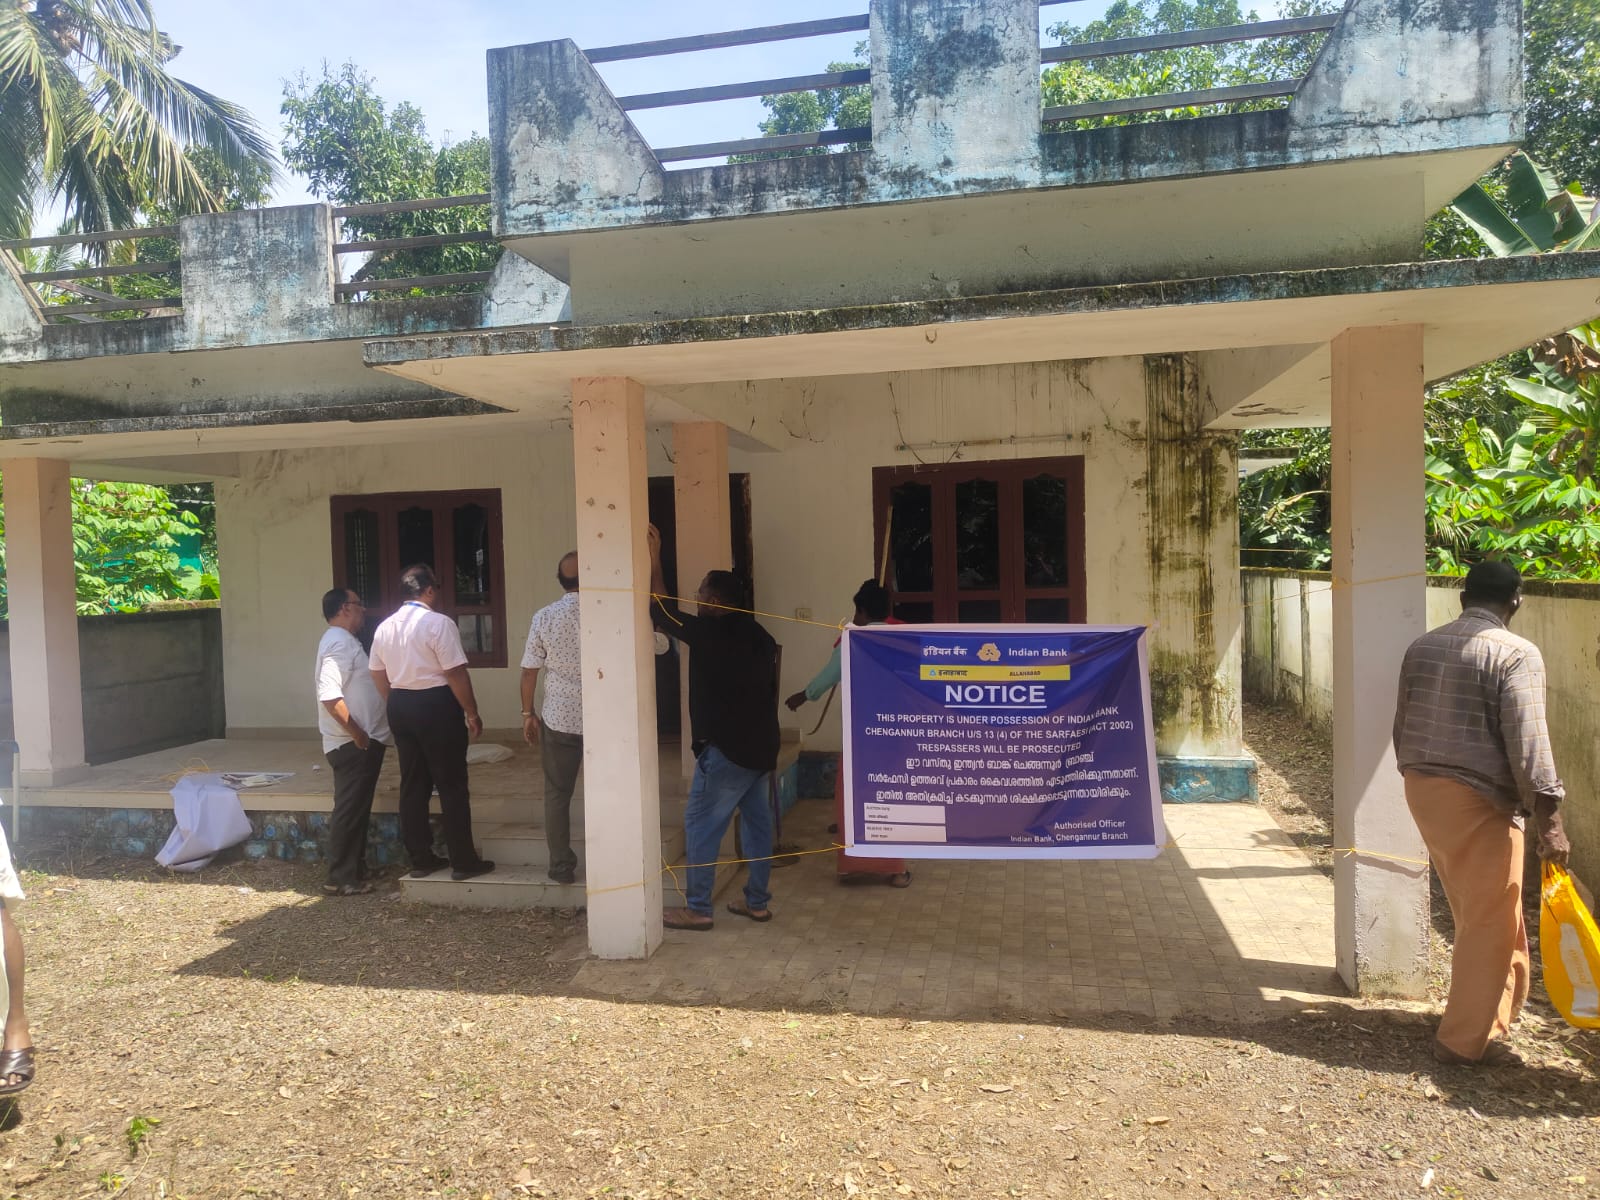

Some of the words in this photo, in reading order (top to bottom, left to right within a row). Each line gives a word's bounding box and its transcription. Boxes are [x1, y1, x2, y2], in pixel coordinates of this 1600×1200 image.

[1009, 648, 1039, 656] Indian
[1042, 648, 1067, 656] Bank
[945, 685, 1046, 703] NOTICE
[877, 713, 895, 722] THIS
[898, 714, 944, 723] PROPERTY
[947, 715, 955, 724] IS
[957, 716, 988, 724] UNDER
[991, 716, 1050, 724] POSSESSION
[1052, 715, 1065, 724] OF
[1095, 706, 1119, 717] BANK
[865, 727, 925, 737] CHENGANNUR
[928, 729, 965, 738] BRANCH
[967, 730, 982, 739] U/S
[985, 730, 995, 738] 13
[996, 731, 1008, 740] (4)
[1010, 730, 1023, 739] OF
[1025, 730, 1043, 739] THE
[1110, 720, 1133, 731] 2002)
[917, 743, 981, 753] TRESPASSERS
[983, 744, 1005, 753] WILL
[1007, 745, 1020, 753] BE
[1022, 741, 1081, 753] PROSECUTED
[906, 758, 920, 769] ഈ
[1054, 820, 1097, 830] Authorised
[1099, 819, 1126, 828] Officer
[1010, 834, 1033, 842] Indian
[1034, 834, 1055, 843] Bank,
[1056, 832, 1100, 842] Chengannur
[1102, 831, 1128, 840] Branch
